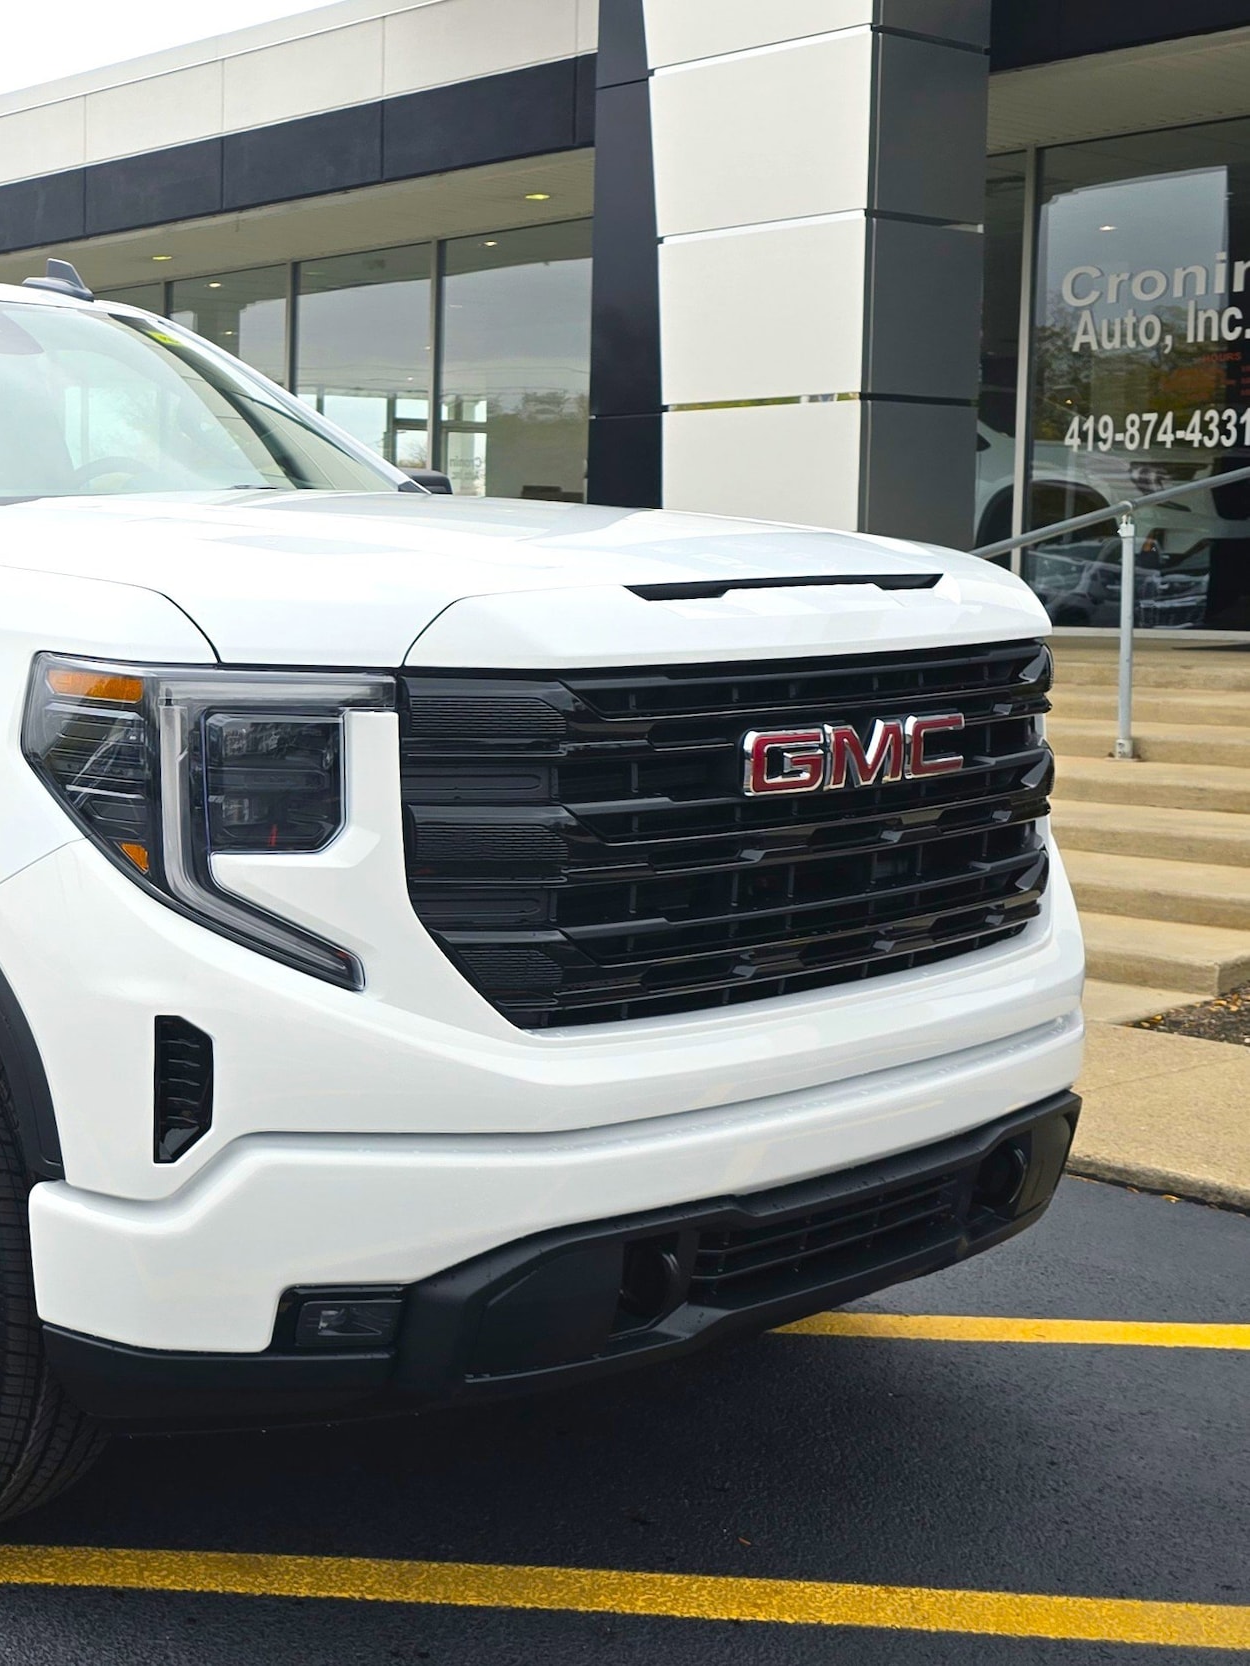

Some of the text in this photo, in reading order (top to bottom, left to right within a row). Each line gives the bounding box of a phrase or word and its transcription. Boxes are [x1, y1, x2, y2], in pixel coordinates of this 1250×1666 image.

[1072, 300, 1250, 354] Auto, Inc.
[1064, 408, 1250, 452] 419-874-4331
[743, 713, 965, 796] GMC
